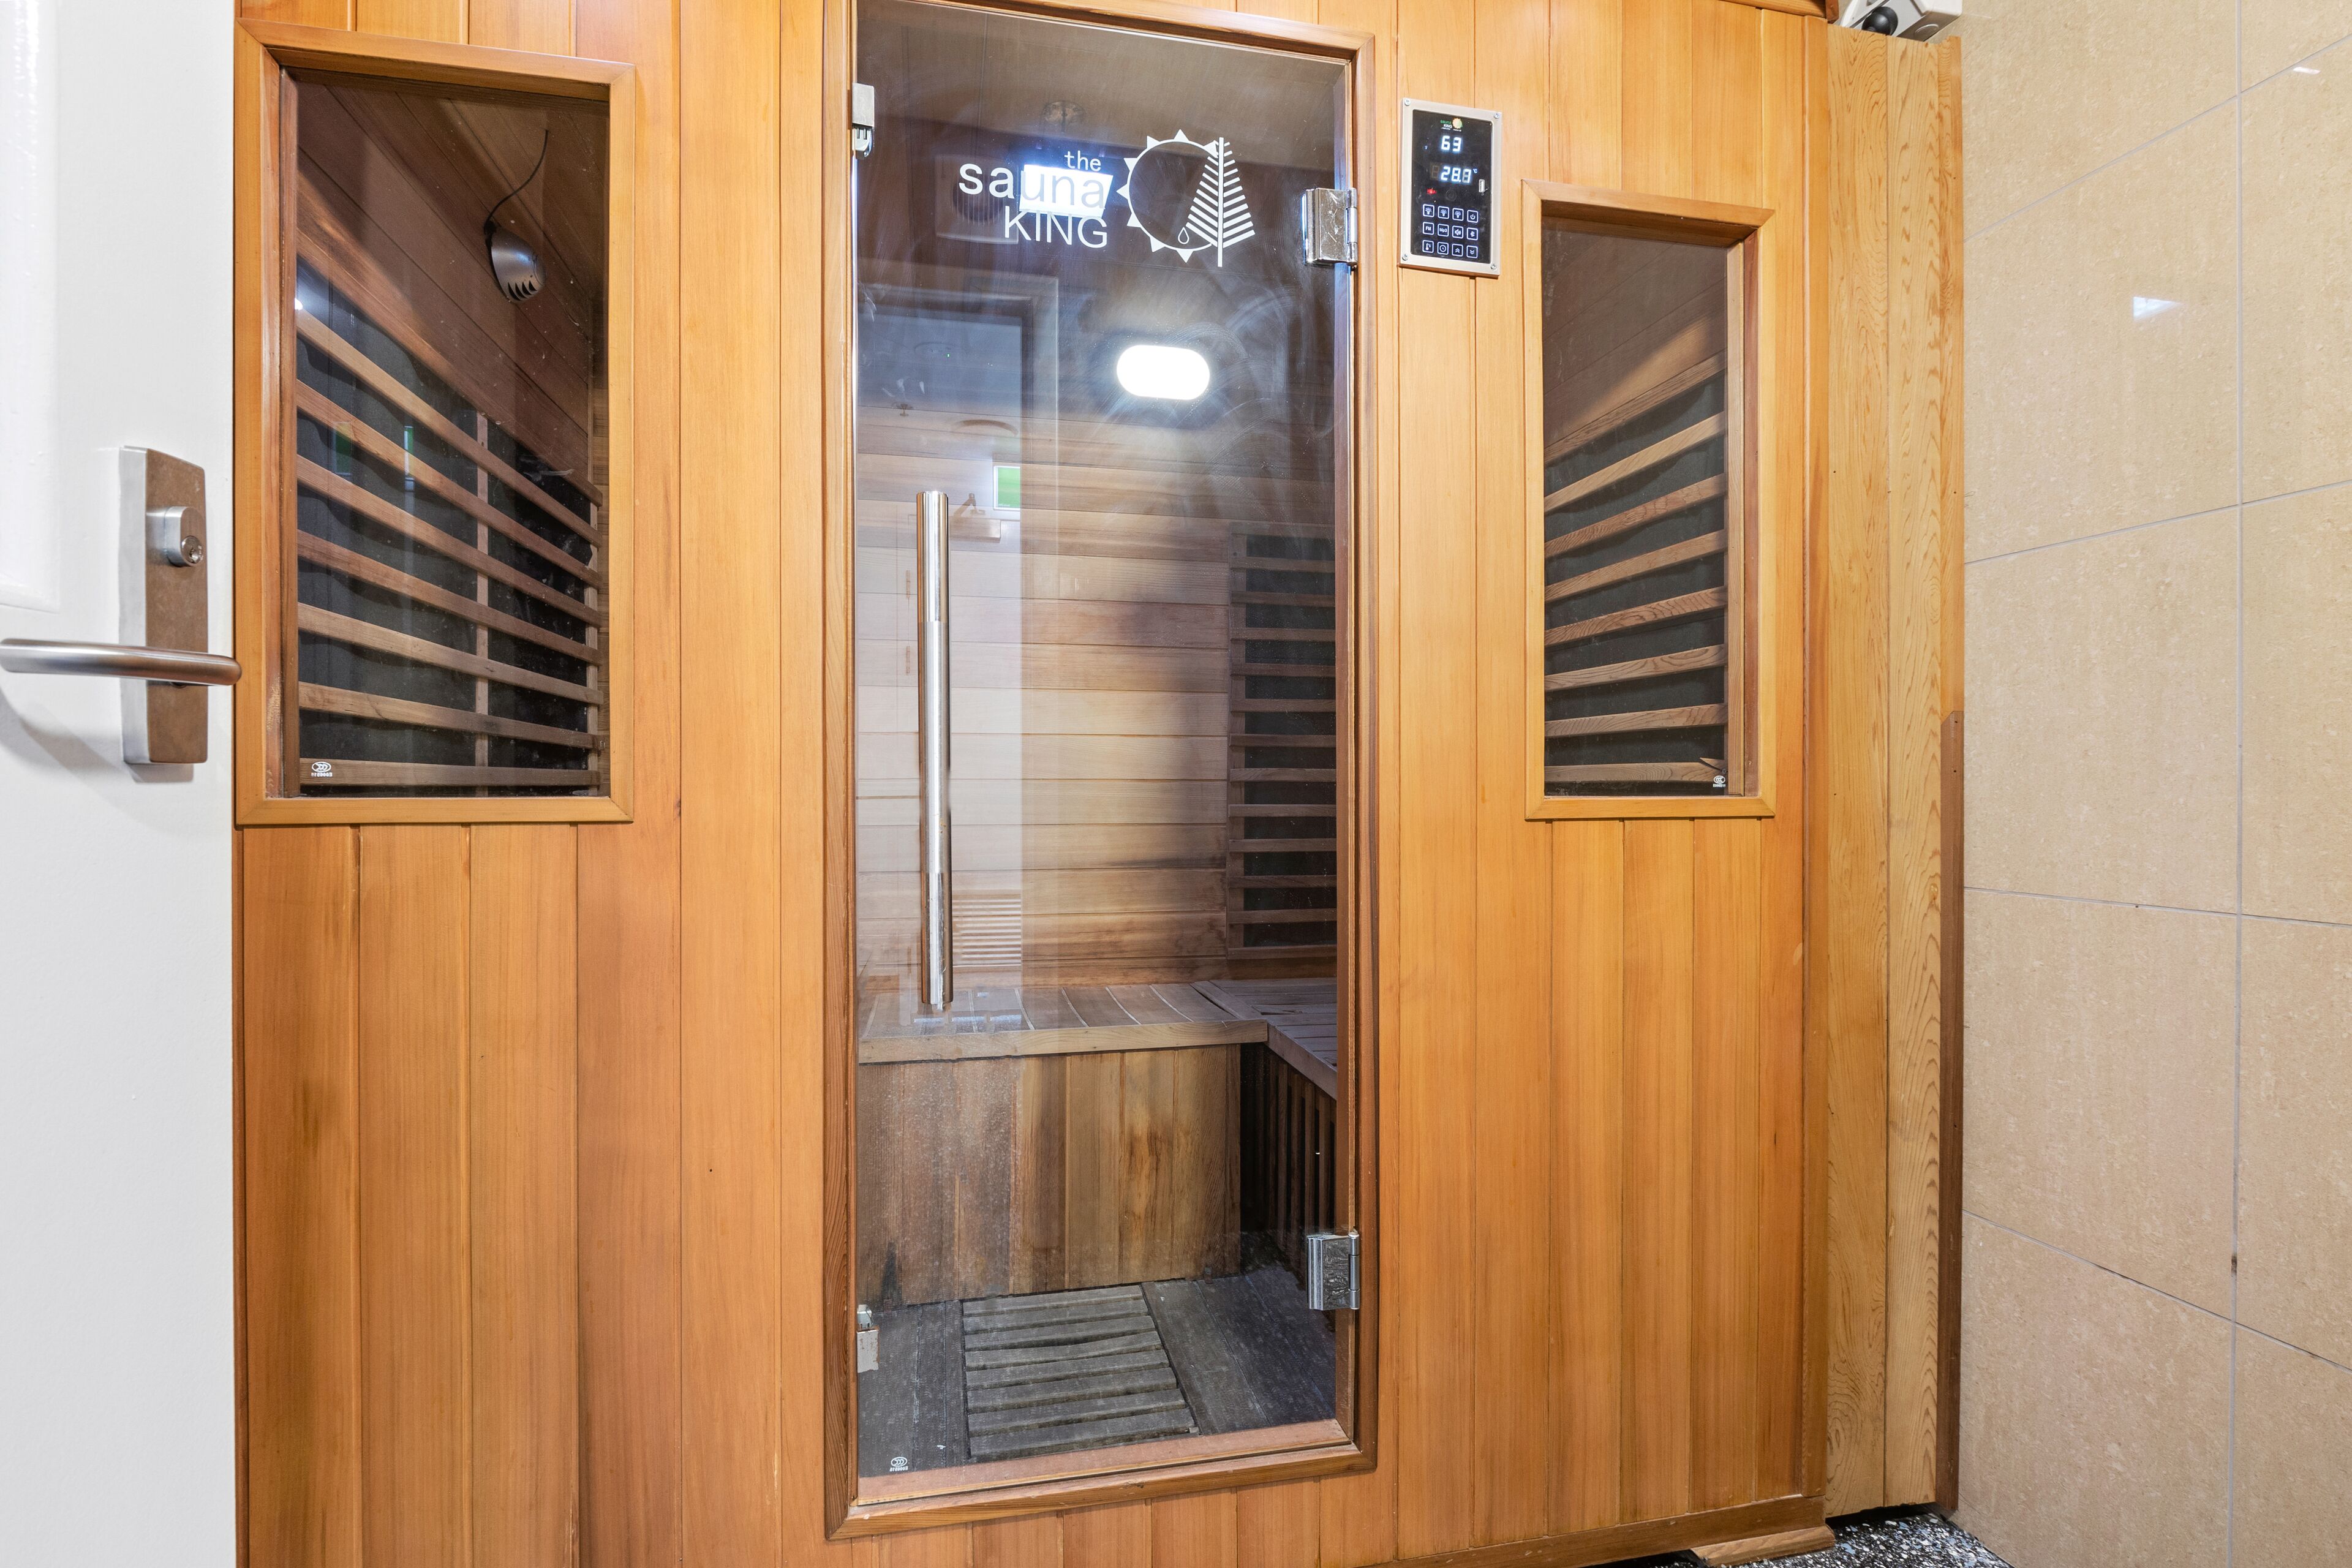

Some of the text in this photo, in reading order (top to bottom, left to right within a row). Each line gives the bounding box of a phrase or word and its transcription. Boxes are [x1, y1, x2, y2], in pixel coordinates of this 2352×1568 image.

[1441, 135, 1461, 152] 63
[1064, 150, 1101, 172] the
[1441, 166, 1471, 183] 28.7
[958, 163, 1106, 209] sauna
[1005, 206, 1107, 249] KING
